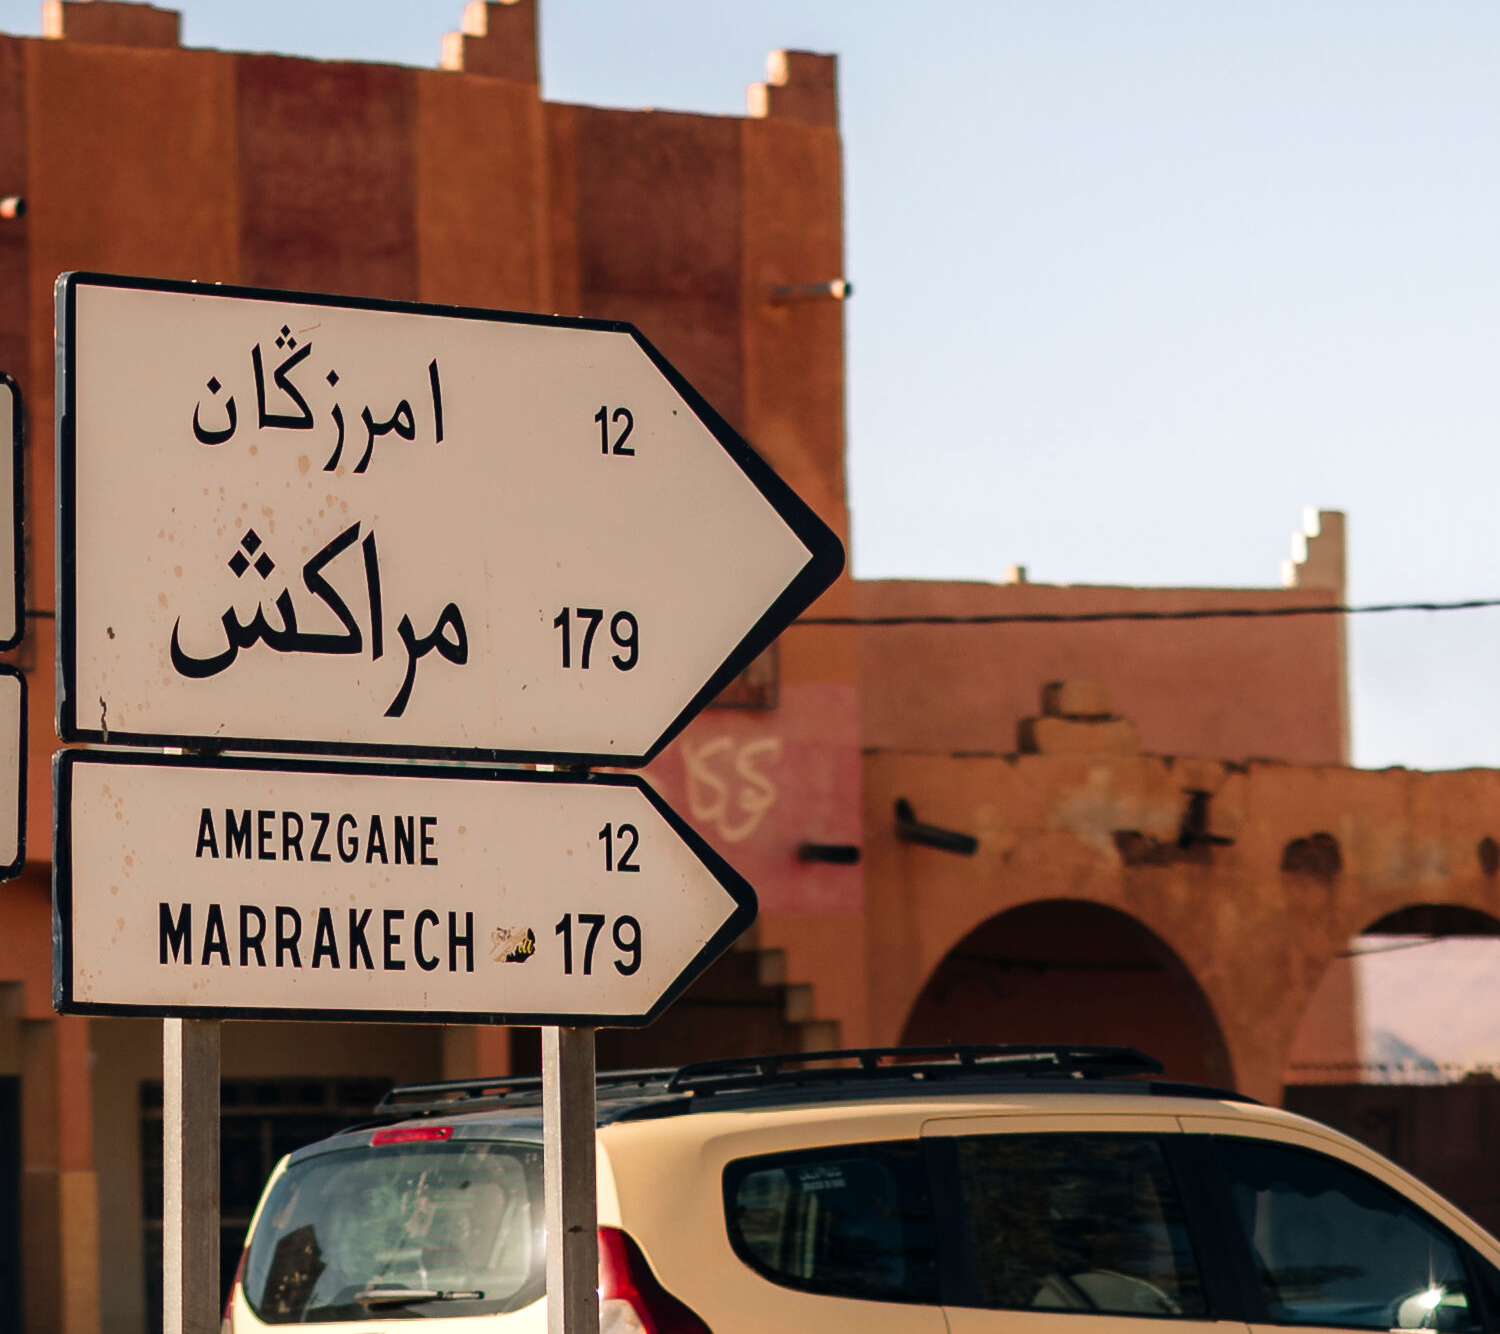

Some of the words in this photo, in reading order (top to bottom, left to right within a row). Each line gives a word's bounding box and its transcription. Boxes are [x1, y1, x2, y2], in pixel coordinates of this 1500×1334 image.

[594, 405, 635, 457] 12
[170, 520, 469, 718] مراكش
[553, 607, 639, 672] 179
[195, 808, 439, 866] AMERZGANE
[598, 822, 640, 873] 12
[159, 902, 474, 973] MARRAKECH
[555, 913, 642, 976] 179
